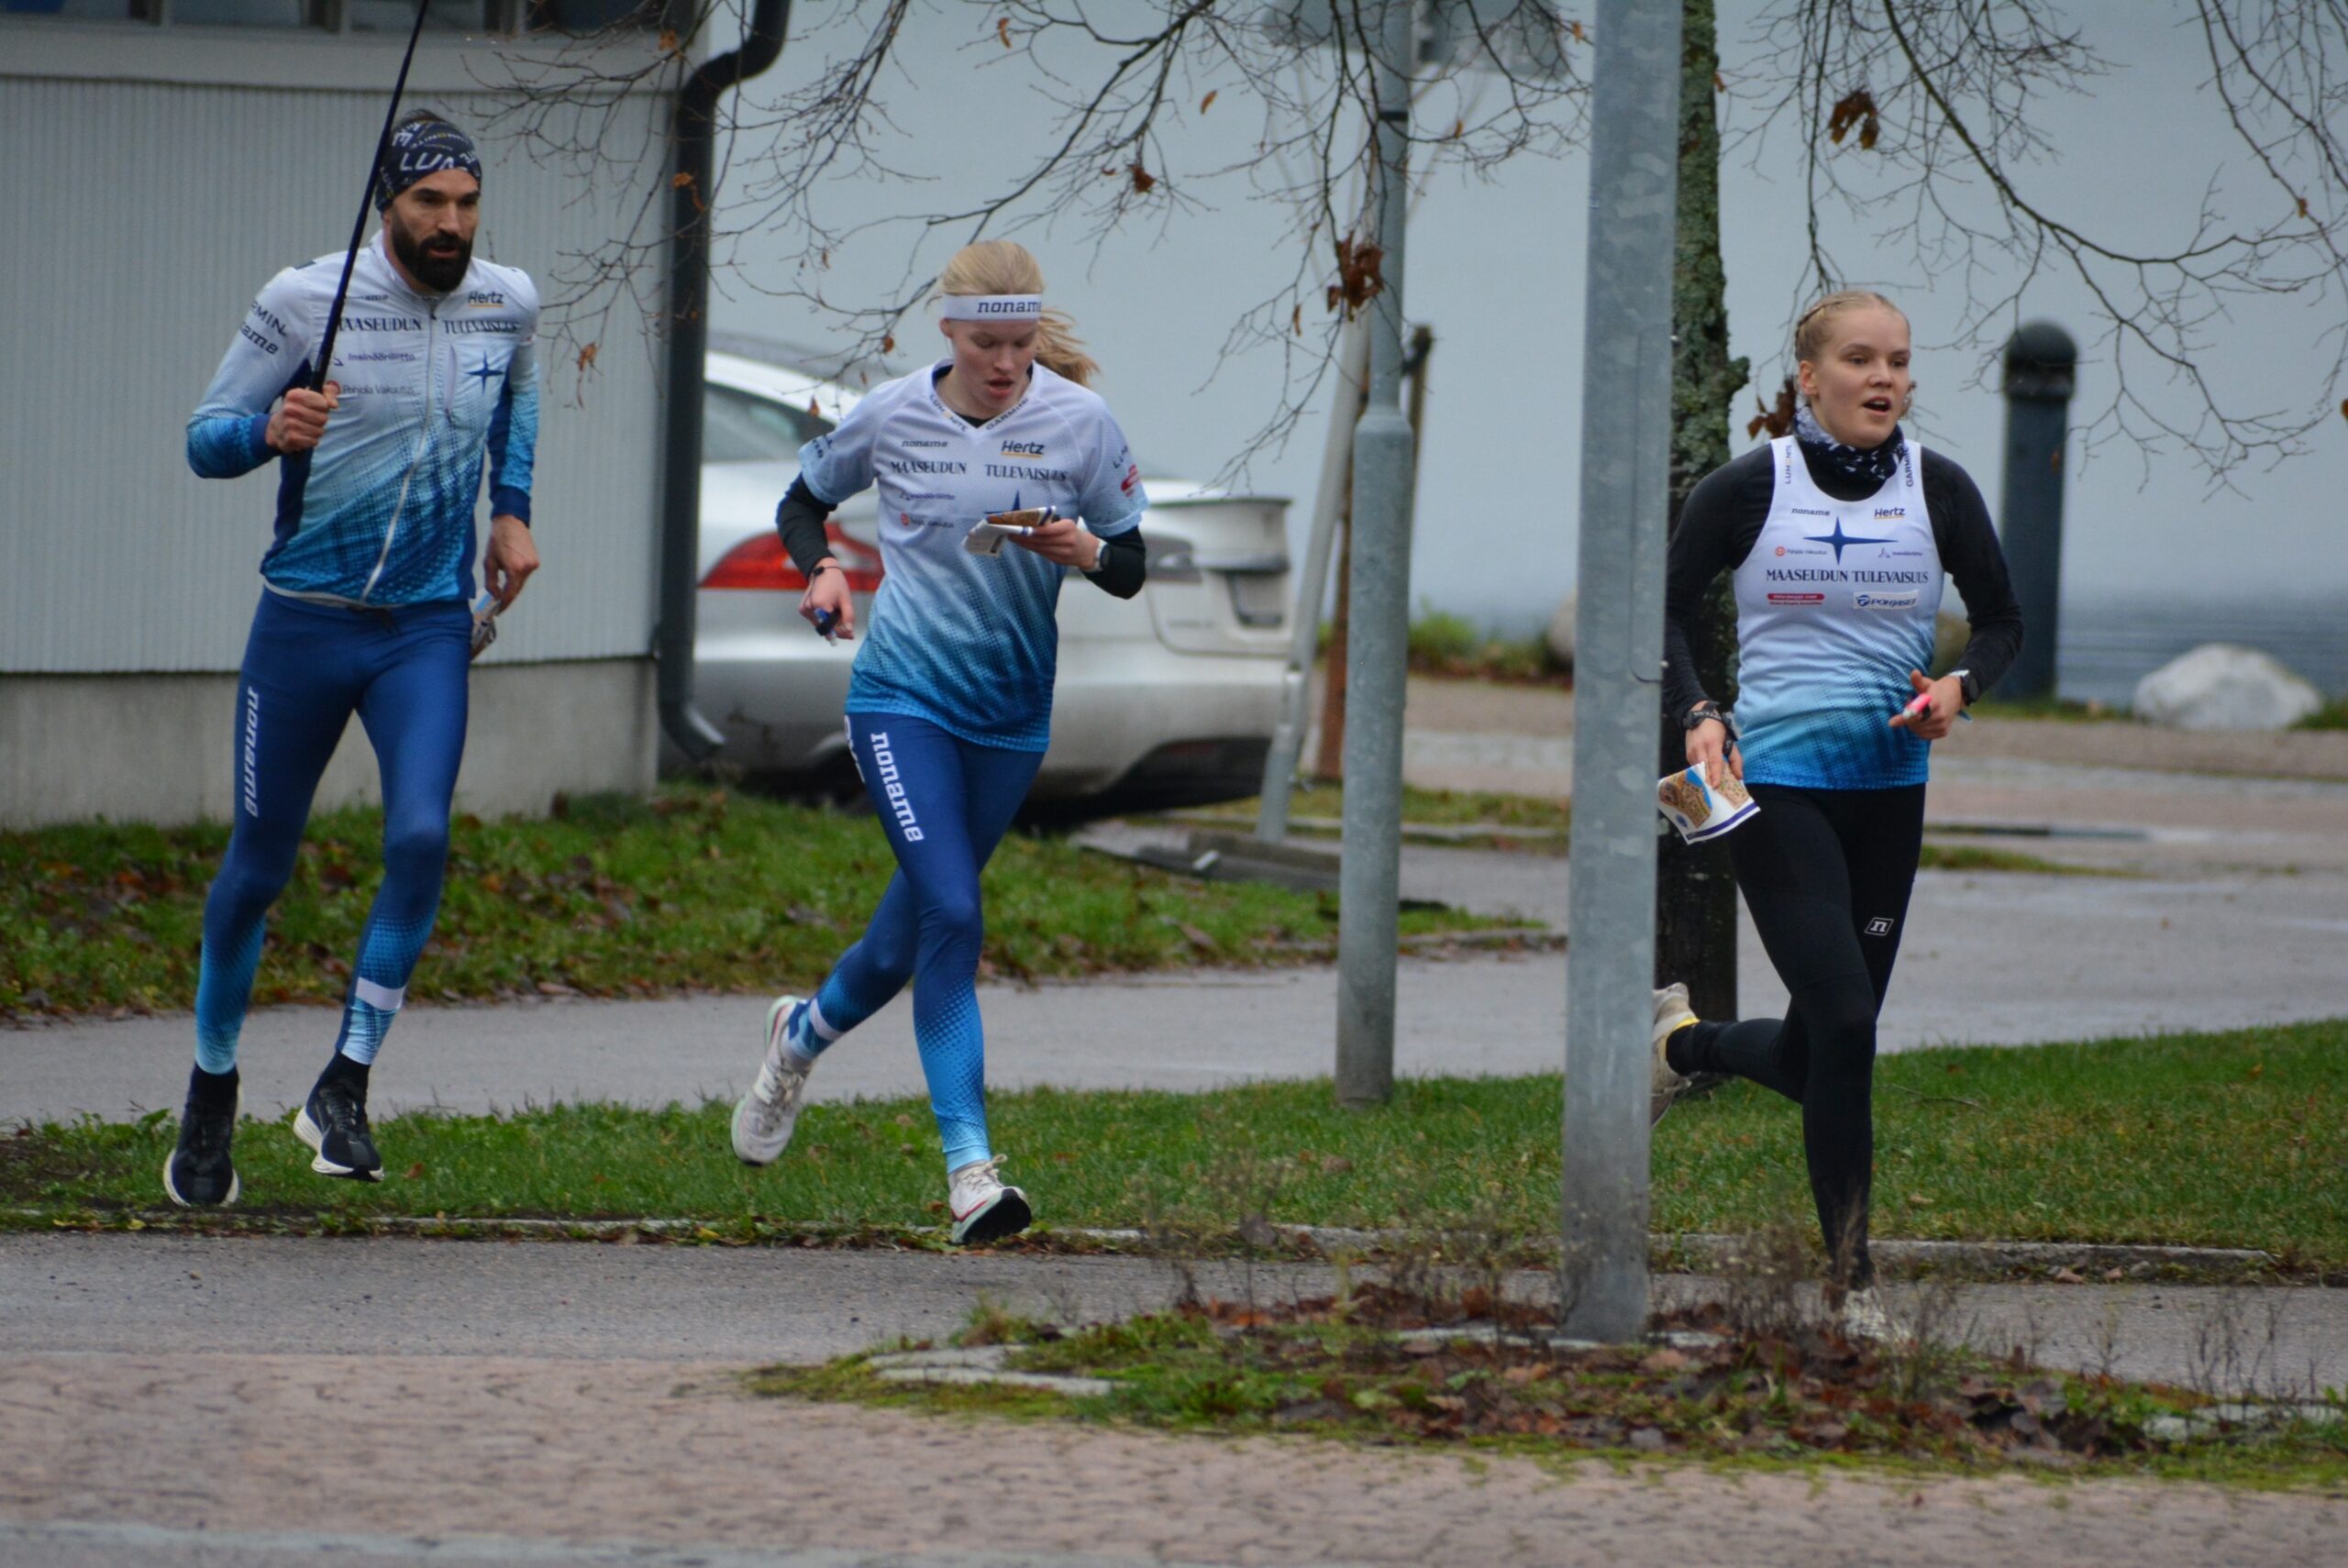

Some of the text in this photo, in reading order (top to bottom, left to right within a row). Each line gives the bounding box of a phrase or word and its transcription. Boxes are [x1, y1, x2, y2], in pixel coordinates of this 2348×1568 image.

[468, 291, 504, 304] Hertz
[1001, 440, 1045, 455] Hertz
[891, 461, 967, 474] MAASEUDUN
[1791, 508, 1831, 516] noname
[1874, 507, 1906, 518] Hertz
[1766, 569, 1929, 583] MAASEUDUN TULEVAISUUS
[244, 686, 260, 819] noname
[870, 733, 925, 842] noname
